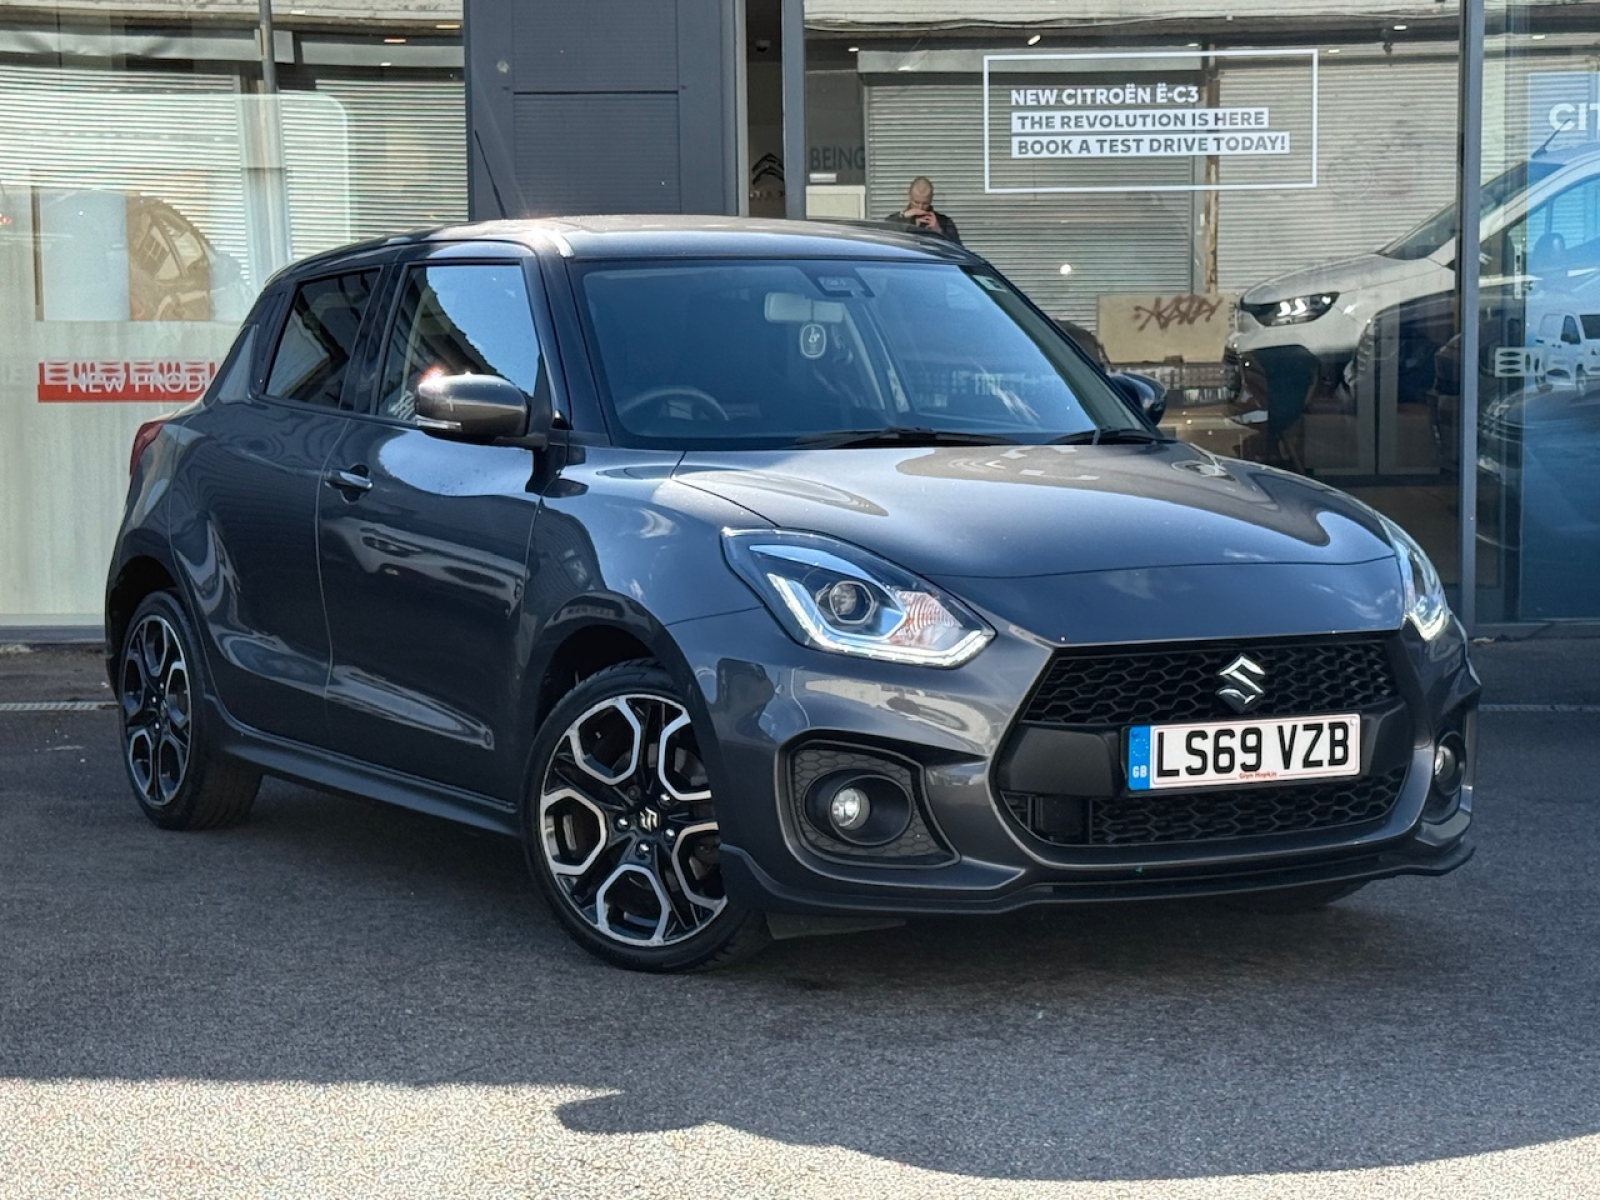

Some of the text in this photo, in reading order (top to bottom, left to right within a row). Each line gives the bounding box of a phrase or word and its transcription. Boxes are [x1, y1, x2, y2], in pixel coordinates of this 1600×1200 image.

[1011, 89, 1057, 105] NEW
[1062, 83, 1151, 104] CITROËN
[1017, 111, 1265, 130] THE REVOLUTION IS HERE
[1017, 134, 1286, 155] BOOK A TEST DRIVE TODAY!
[67, 373, 125, 393] NEW
[1156, 721, 1350, 778] LS69 VZB
[1132, 765, 1148, 778] GB
